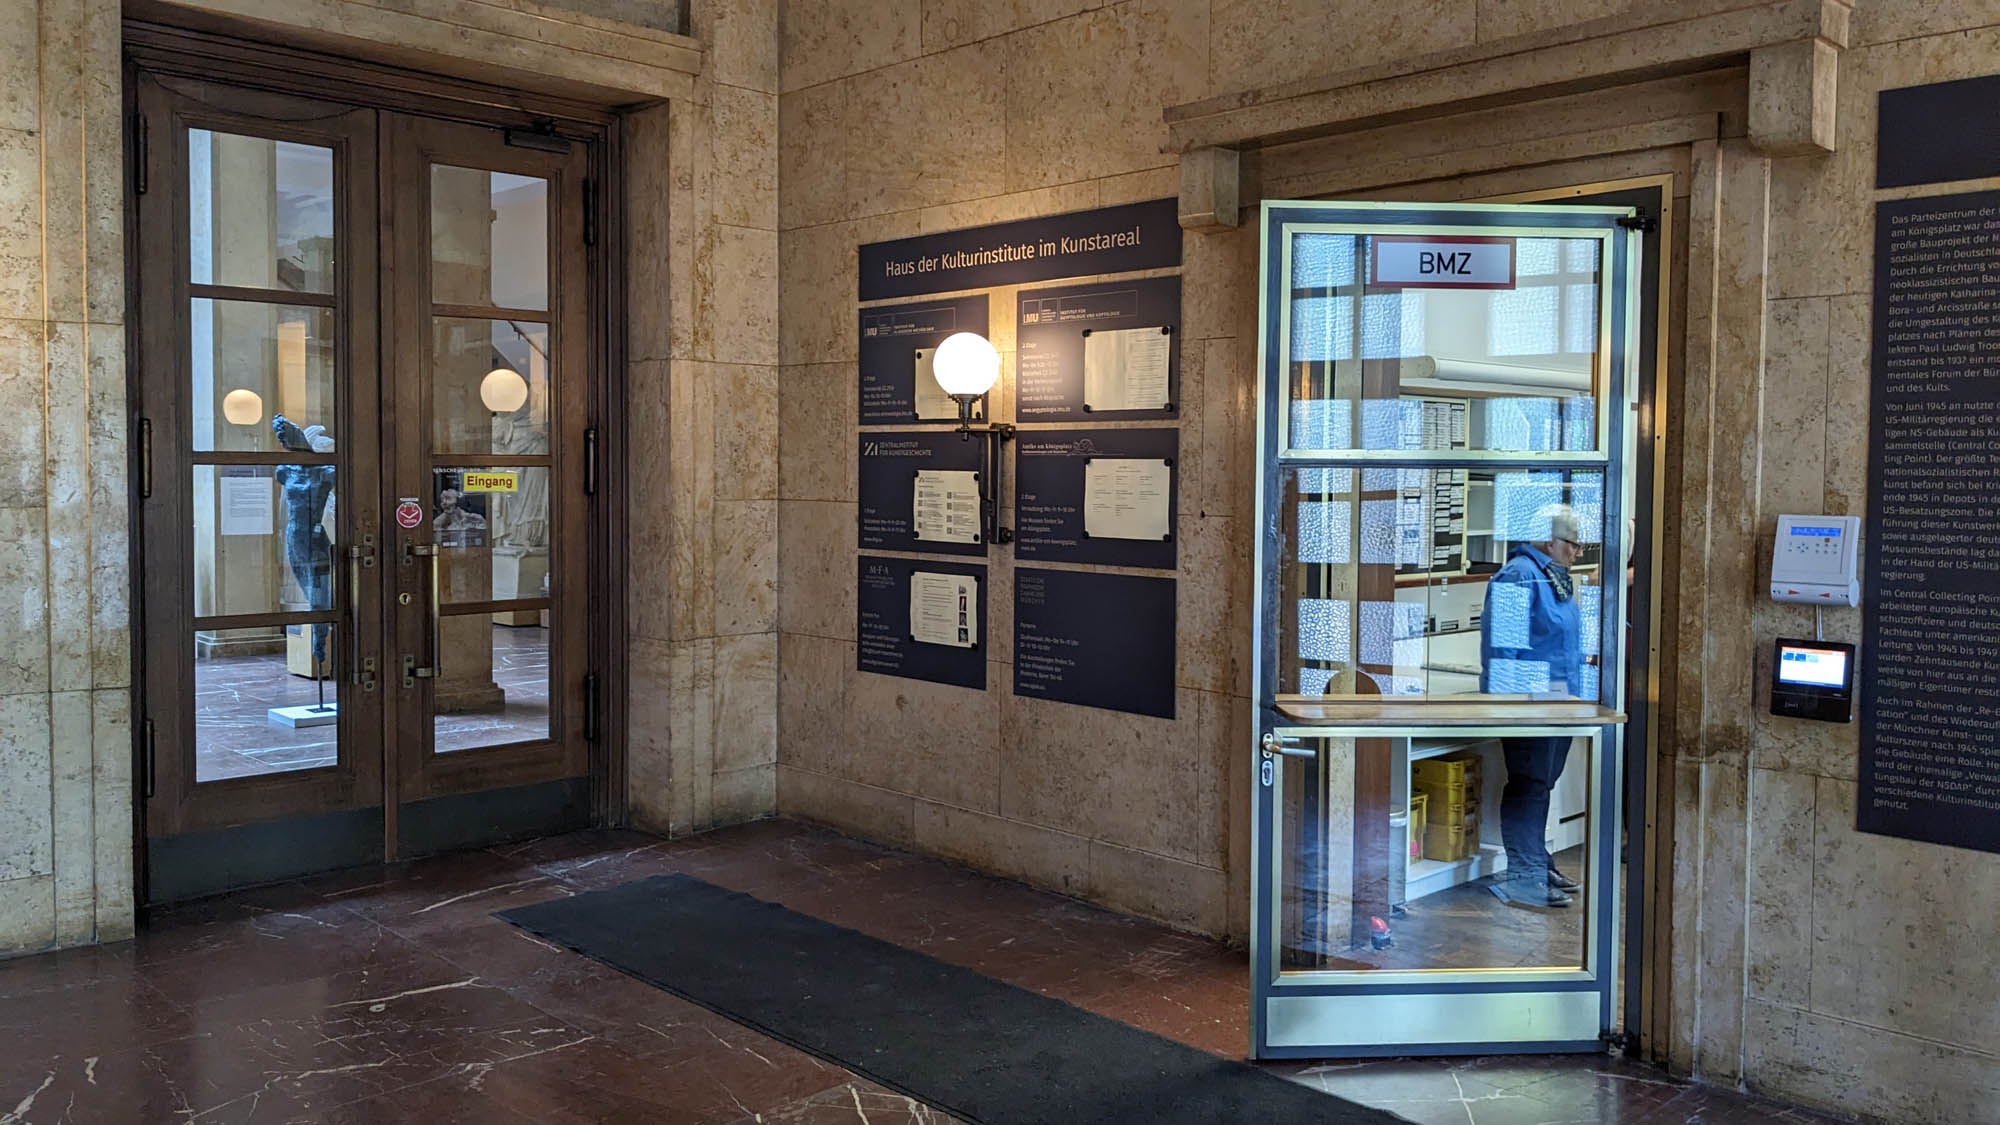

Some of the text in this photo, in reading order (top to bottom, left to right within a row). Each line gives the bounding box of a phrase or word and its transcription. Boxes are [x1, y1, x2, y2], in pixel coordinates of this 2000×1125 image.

[885, 226, 1141, 277] Haus der Kulturinstitute im Kunstareal
[1420, 252, 1472, 274] BMZ
[467, 476, 512, 488] Eingang
